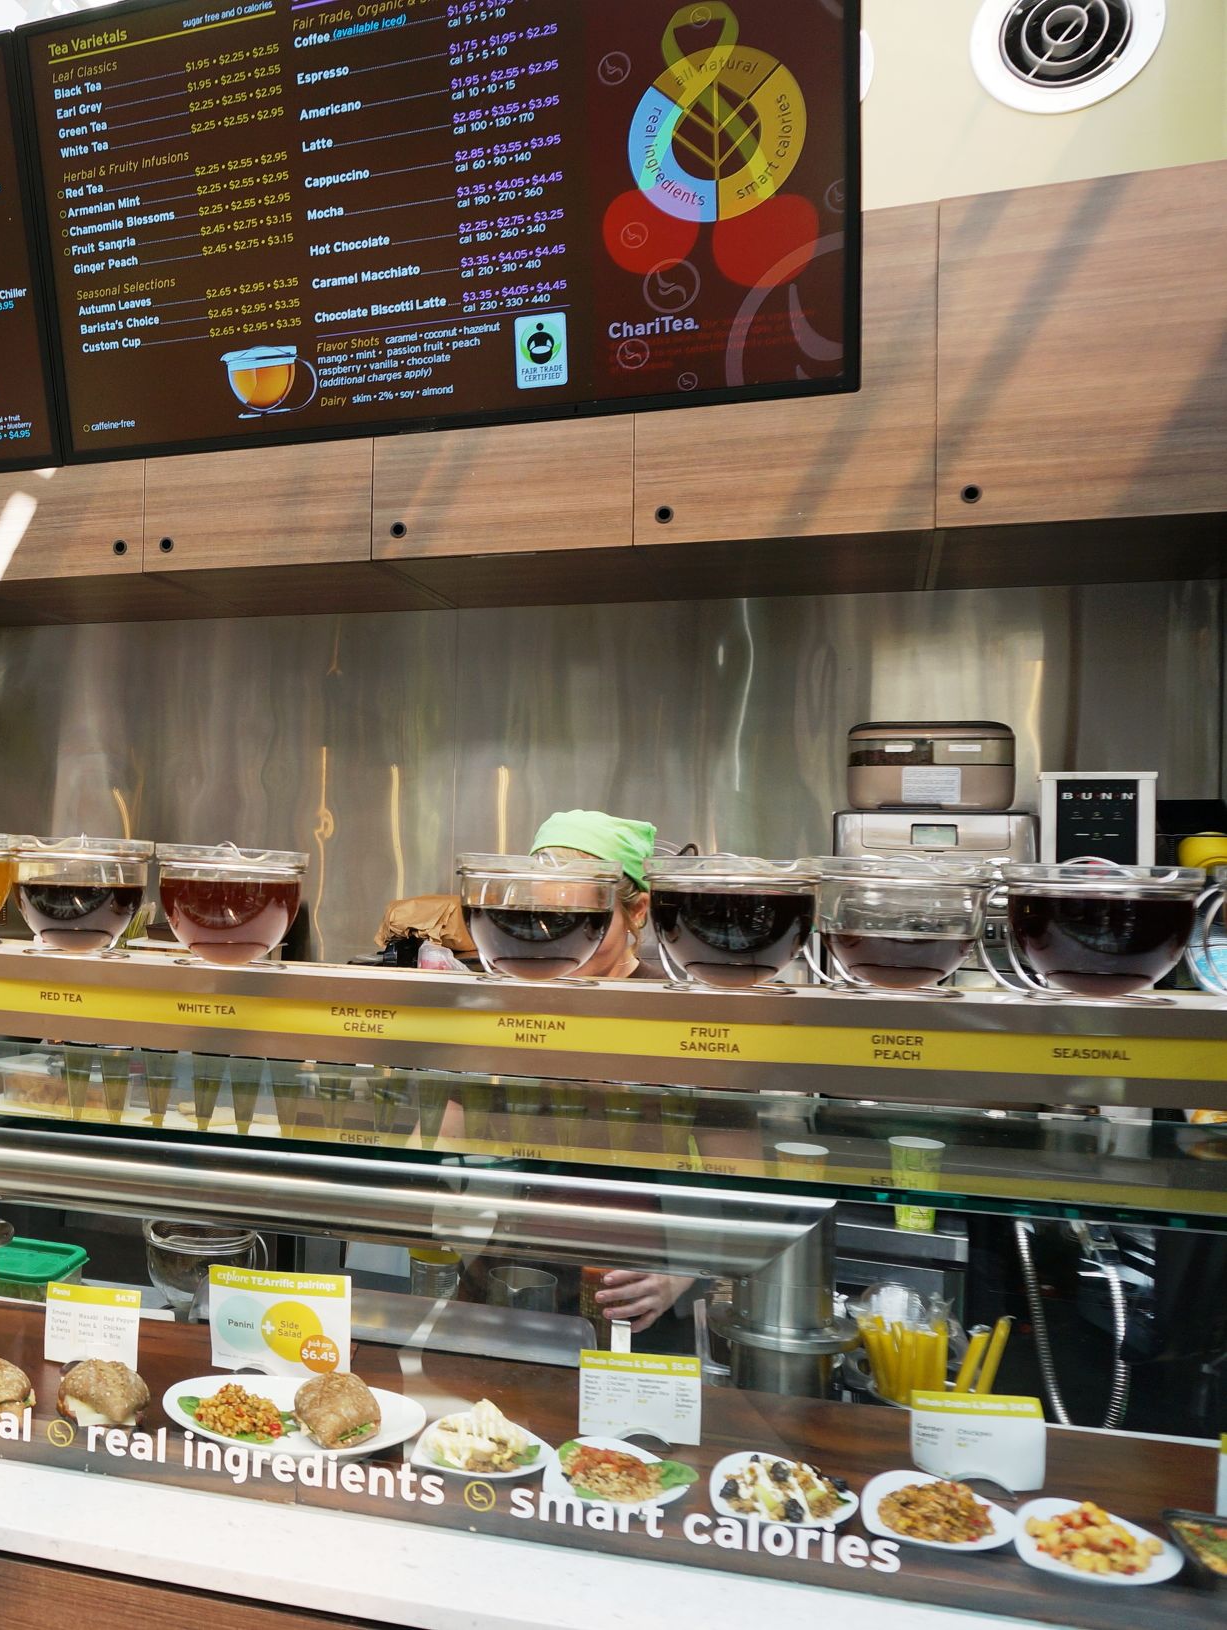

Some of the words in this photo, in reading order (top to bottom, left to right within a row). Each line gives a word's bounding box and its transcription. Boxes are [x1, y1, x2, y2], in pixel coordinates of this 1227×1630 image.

[183, 17, 203, 28] sugar
[205, 14, 220, 24] free
[222, 10, 234, 19] and
[245, 1, 273, 15] calories
[294, 32, 330, 48] Coffee
[333, 21, 379, 40] (available
[382, 15, 406, 30] iced)
[48, 42, 68, 57] Tea
[72, 28, 127, 52] Varietals
[52, 69, 73, 84] Leaf
[77, 60, 117, 78] Classics
[54, 85, 82, 100] Black
[85, 81, 102, 94] Tea
[185, 56, 210, 73] $1.95
[219, 51, 244, 67] $2.25
[253, 43, 279, 60] $2.55
[297, 66, 349, 84] Espresso
[674, 67, 694, 87] all
[698, 57, 758, 75] natural
[56, 107, 76, 120] Earl
[79, 101, 102, 116] Grey
[299, 100, 361, 120] Americano
[58, 125, 87, 139] Green
[89, 120, 107, 133] Tea
[302, 138, 333, 152] Latte
[453, 109, 481, 123] $2.85
[491, 102, 520, 116] $3.55
[528, 96, 560, 109] $3.95
[645, 107, 662, 138] real
[60, 144, 88, 158] White
[91, 139, 109, 152] Tea
[736, 160, 775, 200] smart
[776, 94, 792, 159] calories
[63, 167, 95, 183] Herbal
[98, 164, 105, 175] &
[108, 158, 138, 175] Fruity
[141, 150, 189, 169] Infusions
[645, 143, 705, 206] ingredients
[305, 169, 370, 188] Cappuccino
[65, 186, 83, 199] Red
[86, 183, 103, 195] Tea
[68, 201, 115, 219] Armenian
[118, 195, 140, 209] Mint
[307, 206, 344, 220] Mocha
[69, 218, 123, 237] Chamomile
[127, 209, 174, 228] Blossoms
[71, 242, 94, 256] Fruit
[97, 236, 136, 254] Sangria
[310, 244, 330, 256] Hot
[333, 235, 390, 253] Chocolate
[74, 260, 104, 276] Ginger
[108, 254, 138, 269] Peach
[312, 273, 358, 289] Caramel
[361, 265, 420, 282] Macchiato
[0, 288, 27, 300] Chiller
[77, 284, 120, 300] Seasonal
[123, 278, 176, 293] Selections
[78, 302, 116, 316] Autumn
[118, 297, 152, 311] Leaves
[314, 307, 368, 323] Chocolate
[371, 300, 413, 316] Biscotti
[416, 297, 446, 309] Latte
[126, 315, 160, 327] Choice
[82, 340, 119, 353] Custom
[122, 337, 141, 349] Cup
[521, 367, 540, 375] FAIR
[542, 365, 562, 373] TRADE
[524, 372, 560, 382] CERTIFIED
[40, 991, 60, 1002] RED
[63, 992, 83, 1004] TEA
[177, 1003, 212, 1015] WHITE
[215, 1005, 235, 1016] TEA
[331, 1007, 358, 1019] EARL
[362, 1008, 396, 1021] GREY
[497, 1017, 566, 1032] ARMENIAN
[690, 1027, 729, 1039] FRUIT
[515, 1032, 546, 1044] MINT
[679, 1040, 740, 1053] SANGRIA
[872, 1035, 924, 1048] GINGER
[874, 1048, 921, 1061] PEACH
[1052, 1047, 1131, 1061] SEASONAL
[217, 1271, 248, 1284] explore
[251, 1276, 294, 1288] TEArrific
[297, 1280, 336, 1291] pairings
[228, 1319, 254, 1329] Panini
[278, 1329, 302, 1338] Salad
[280, 1321, 299, 1329] Side
[302, 1348, 336, 1362] $6.45
[87, 1425, 165, 1464] real
[184, 1431, 445, 1506] ingredients
[510, 1483, 664, 1539] smart
[683, 1508, 901, 1573] calories
